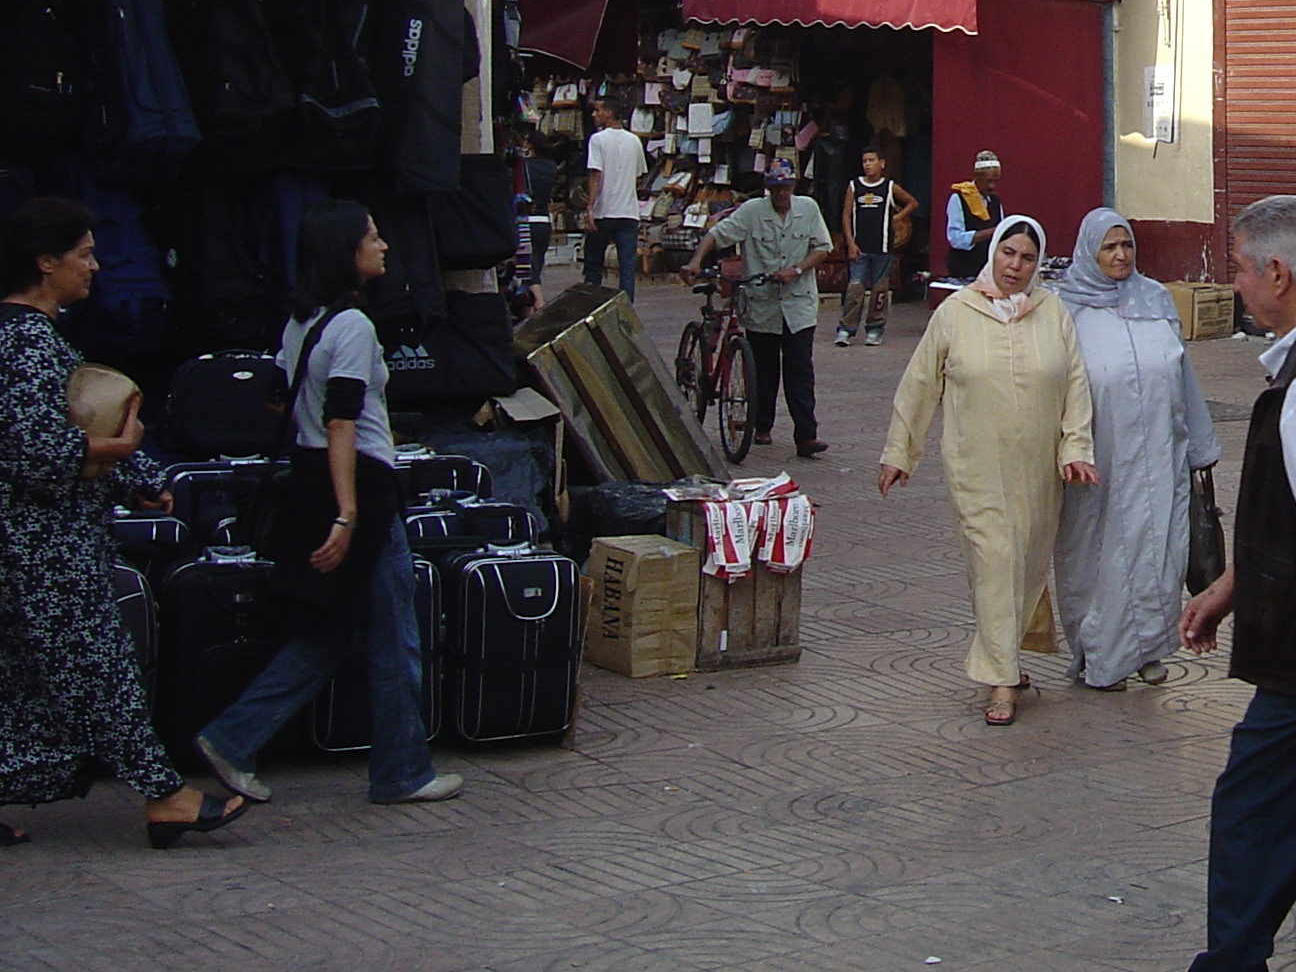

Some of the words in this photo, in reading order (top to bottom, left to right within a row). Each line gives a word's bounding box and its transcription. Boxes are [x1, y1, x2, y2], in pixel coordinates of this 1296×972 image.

[401, 18, 423, 77] adidas
[711, 505, 722, 547] Marlbor
[784, 503, 799, 548] Marlboro
[602, 556, 624, 639] HABANA
